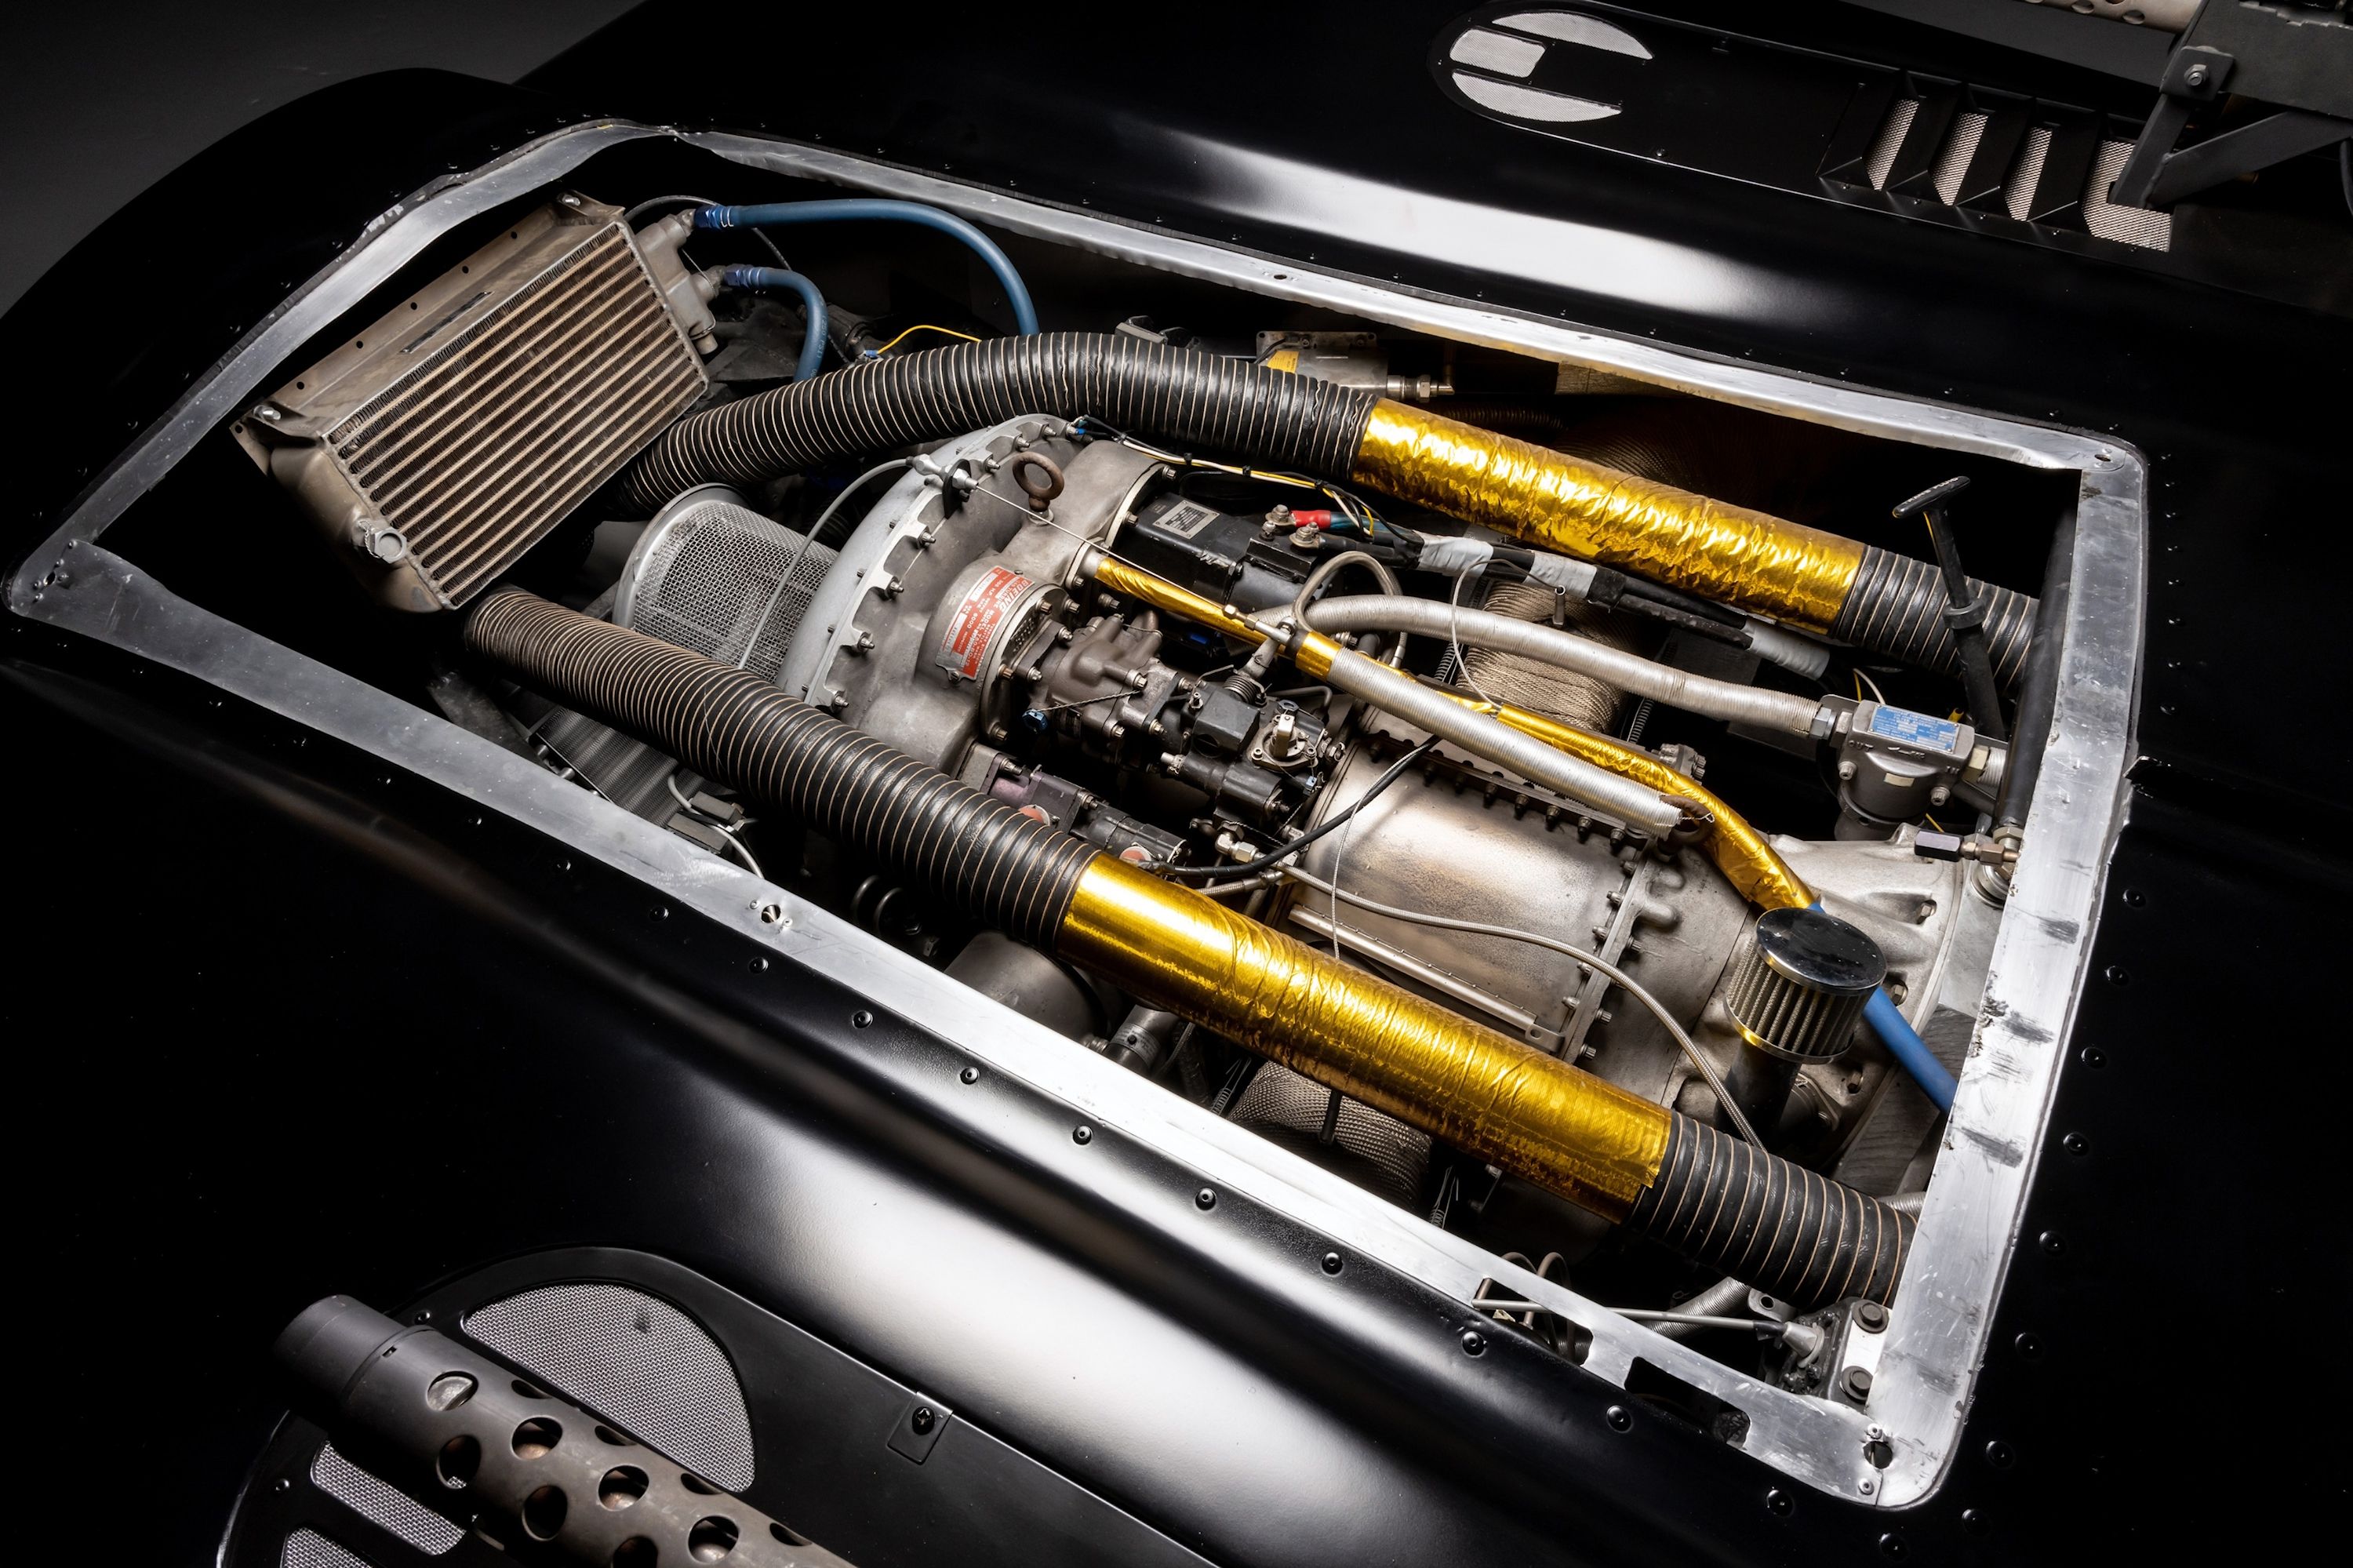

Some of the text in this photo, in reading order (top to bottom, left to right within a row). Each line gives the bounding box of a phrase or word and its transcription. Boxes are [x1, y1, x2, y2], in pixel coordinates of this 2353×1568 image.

[993, 587, 1012, 608] TURBINE
[998, 580, 1028, 612] BOEING
[979, 609, 994, 631] MODEL
[1849, 740, 1874, 752] OUT
